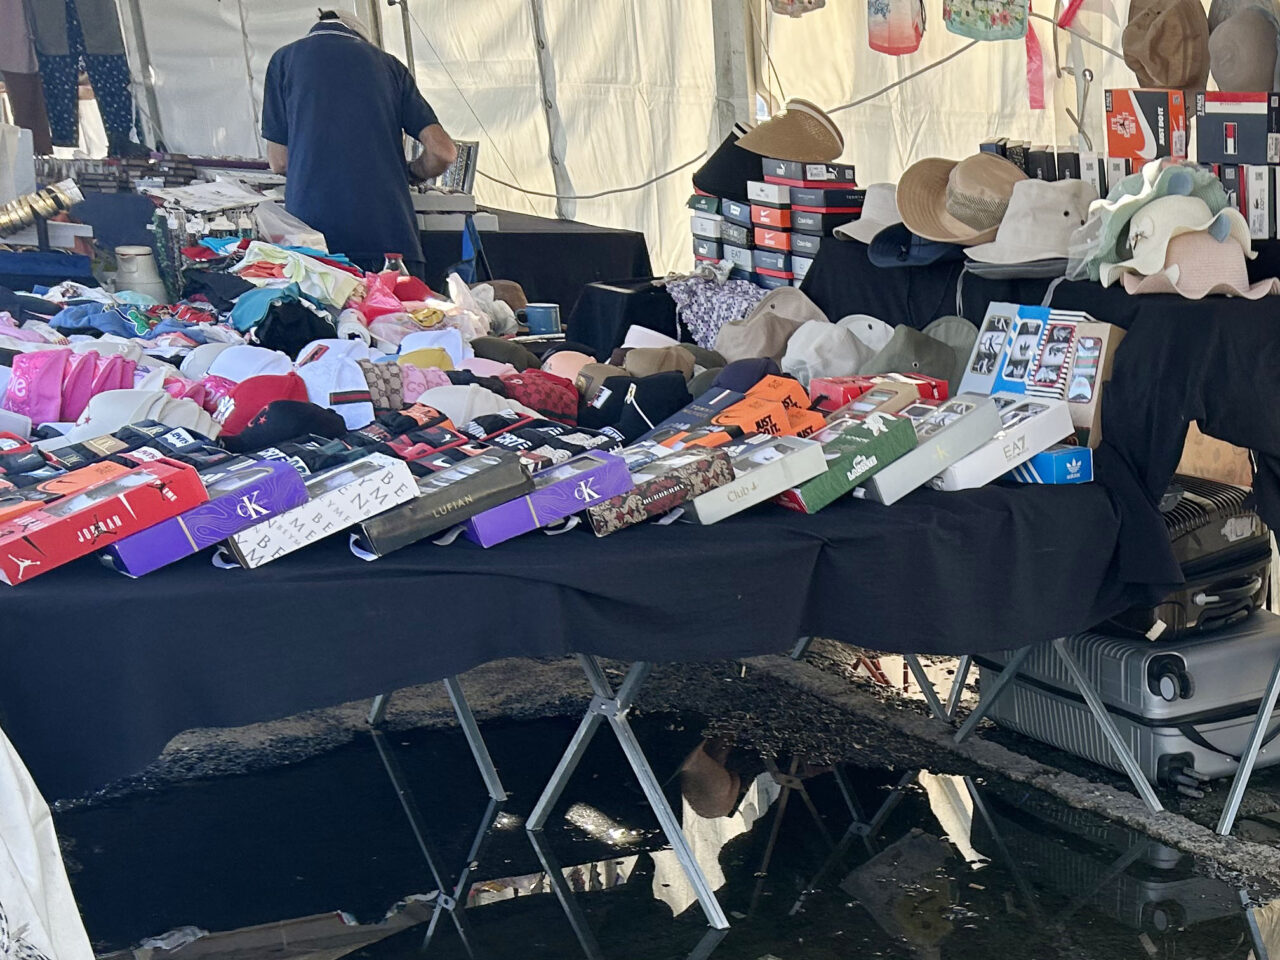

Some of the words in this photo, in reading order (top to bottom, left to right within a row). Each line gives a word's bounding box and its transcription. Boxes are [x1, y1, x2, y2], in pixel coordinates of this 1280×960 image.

[755, 414, 773, 432] JUST
[1002, 434, 1026, 459] EA7
[431, 494, 474, 518] LUFIAN
